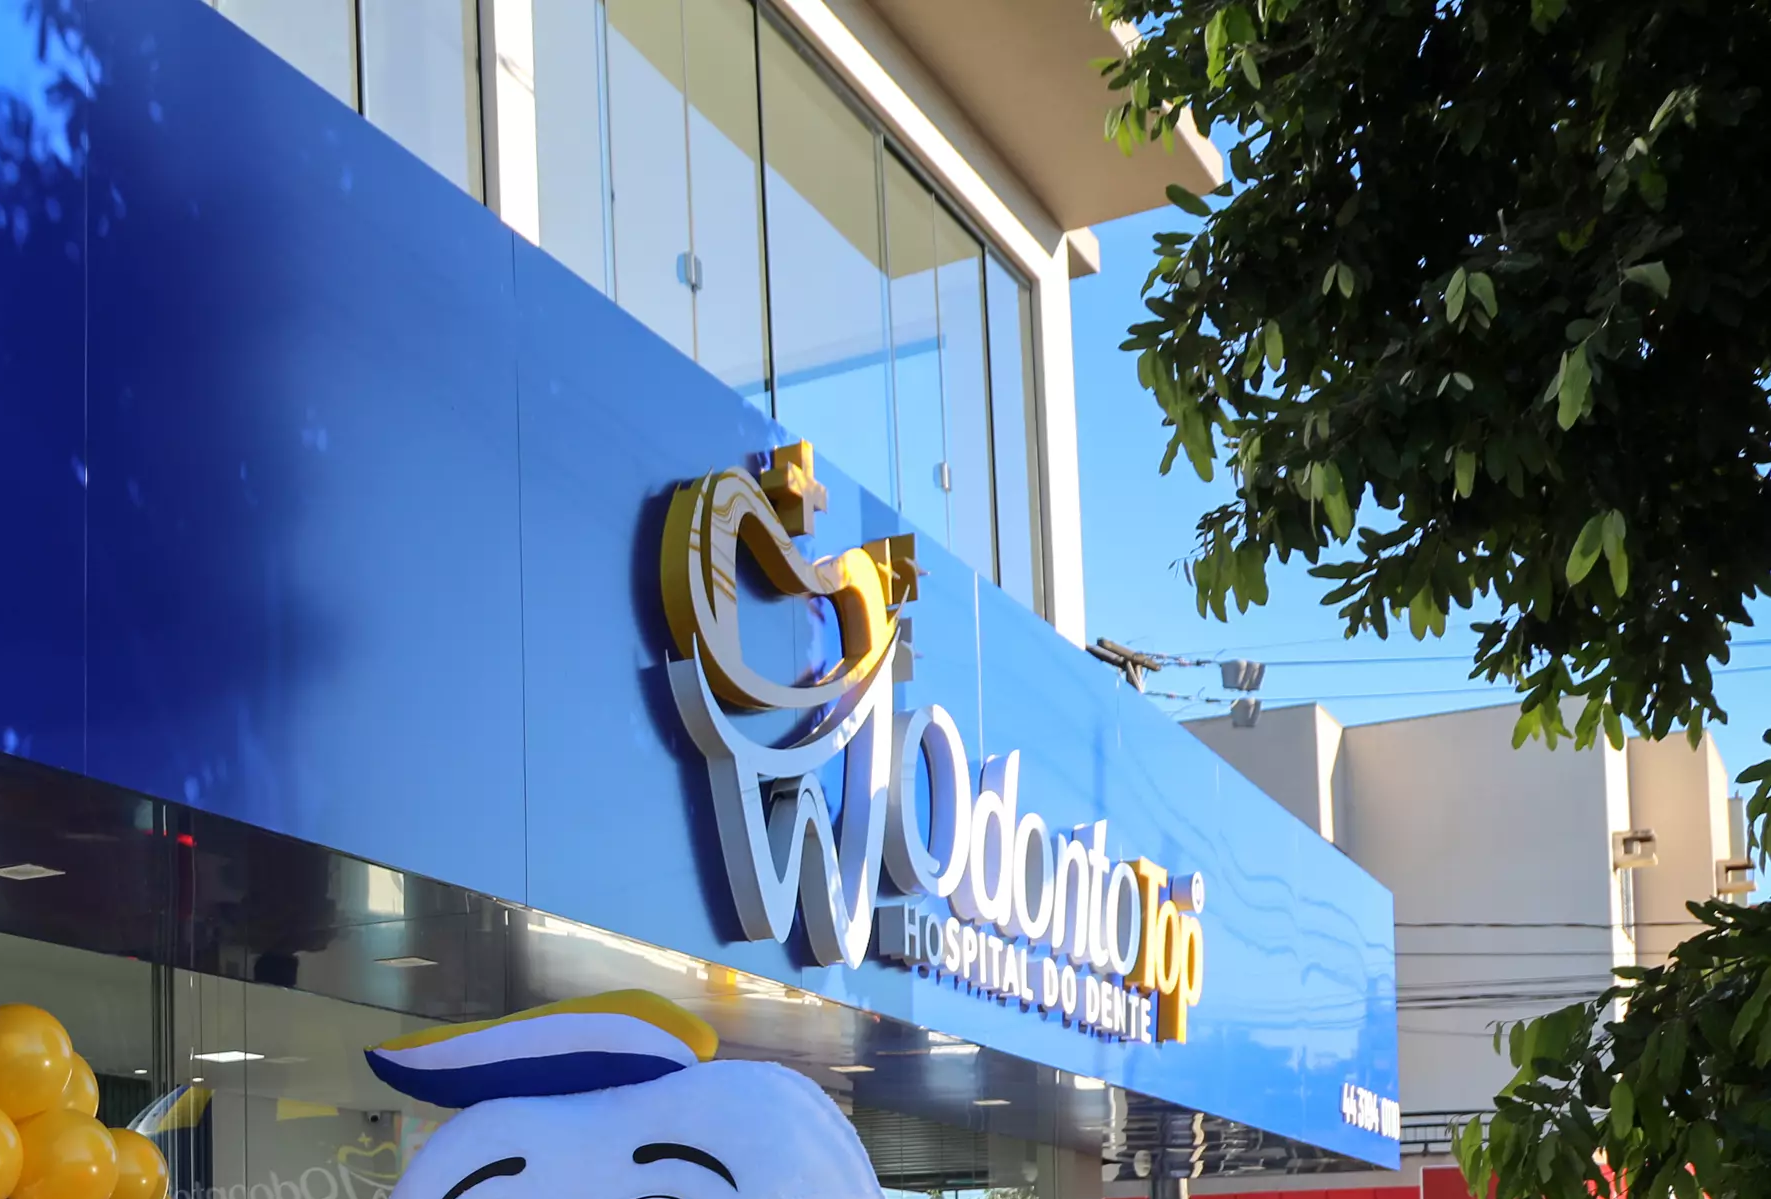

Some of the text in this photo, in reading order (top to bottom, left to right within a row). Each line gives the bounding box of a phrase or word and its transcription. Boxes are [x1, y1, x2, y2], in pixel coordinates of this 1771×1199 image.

[903, 902, 1152, 1044] HOSPITAL DO DENTE
